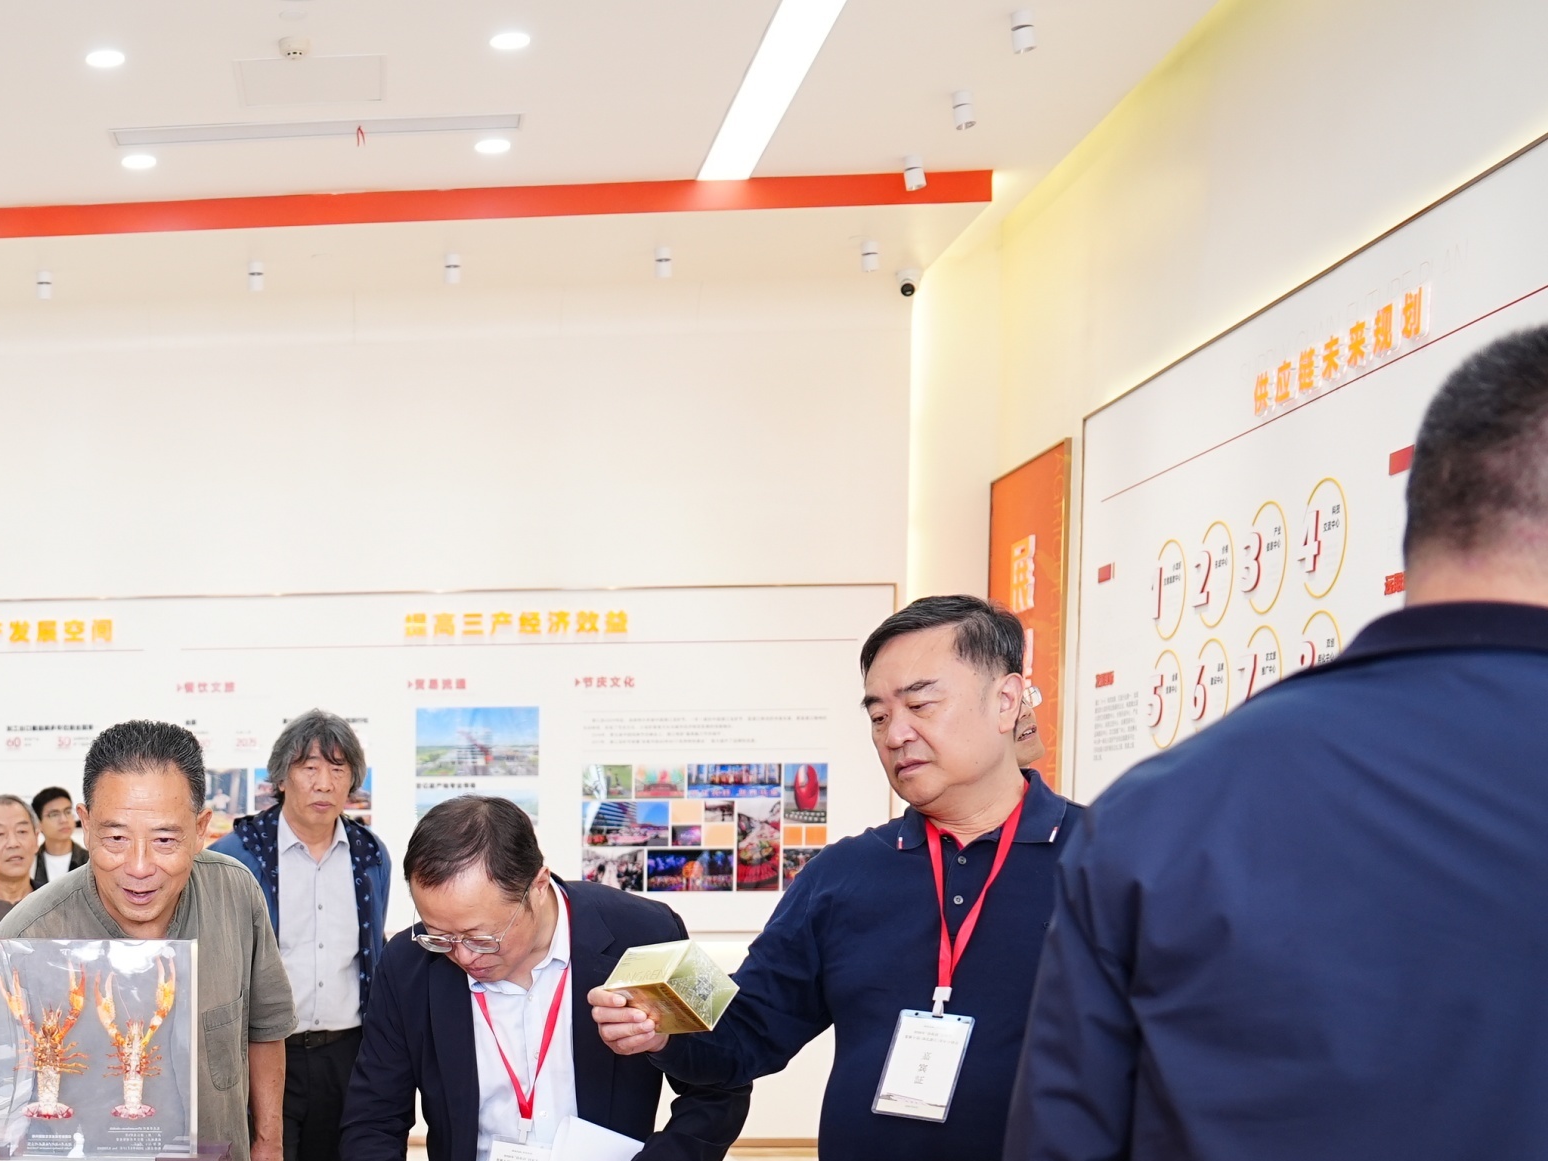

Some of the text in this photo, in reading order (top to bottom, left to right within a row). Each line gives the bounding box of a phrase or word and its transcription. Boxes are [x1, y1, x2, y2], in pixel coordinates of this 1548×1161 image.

[1254, 286, 1423, 417] 供应链未来规划
[1241, 531, 1263, 593] 3
[1297, 510, 1322, 573] 4
[1151, 566, 1163, 620] 1
[1192, 550, 1212, 608] 2
[404, 610, 628, 637] 提高三产经济效益
[582, 676, 635, 689] 节庆文化
[1148, 674, 1164, 728] 5
[1192, 665, 1207, 722] 6
